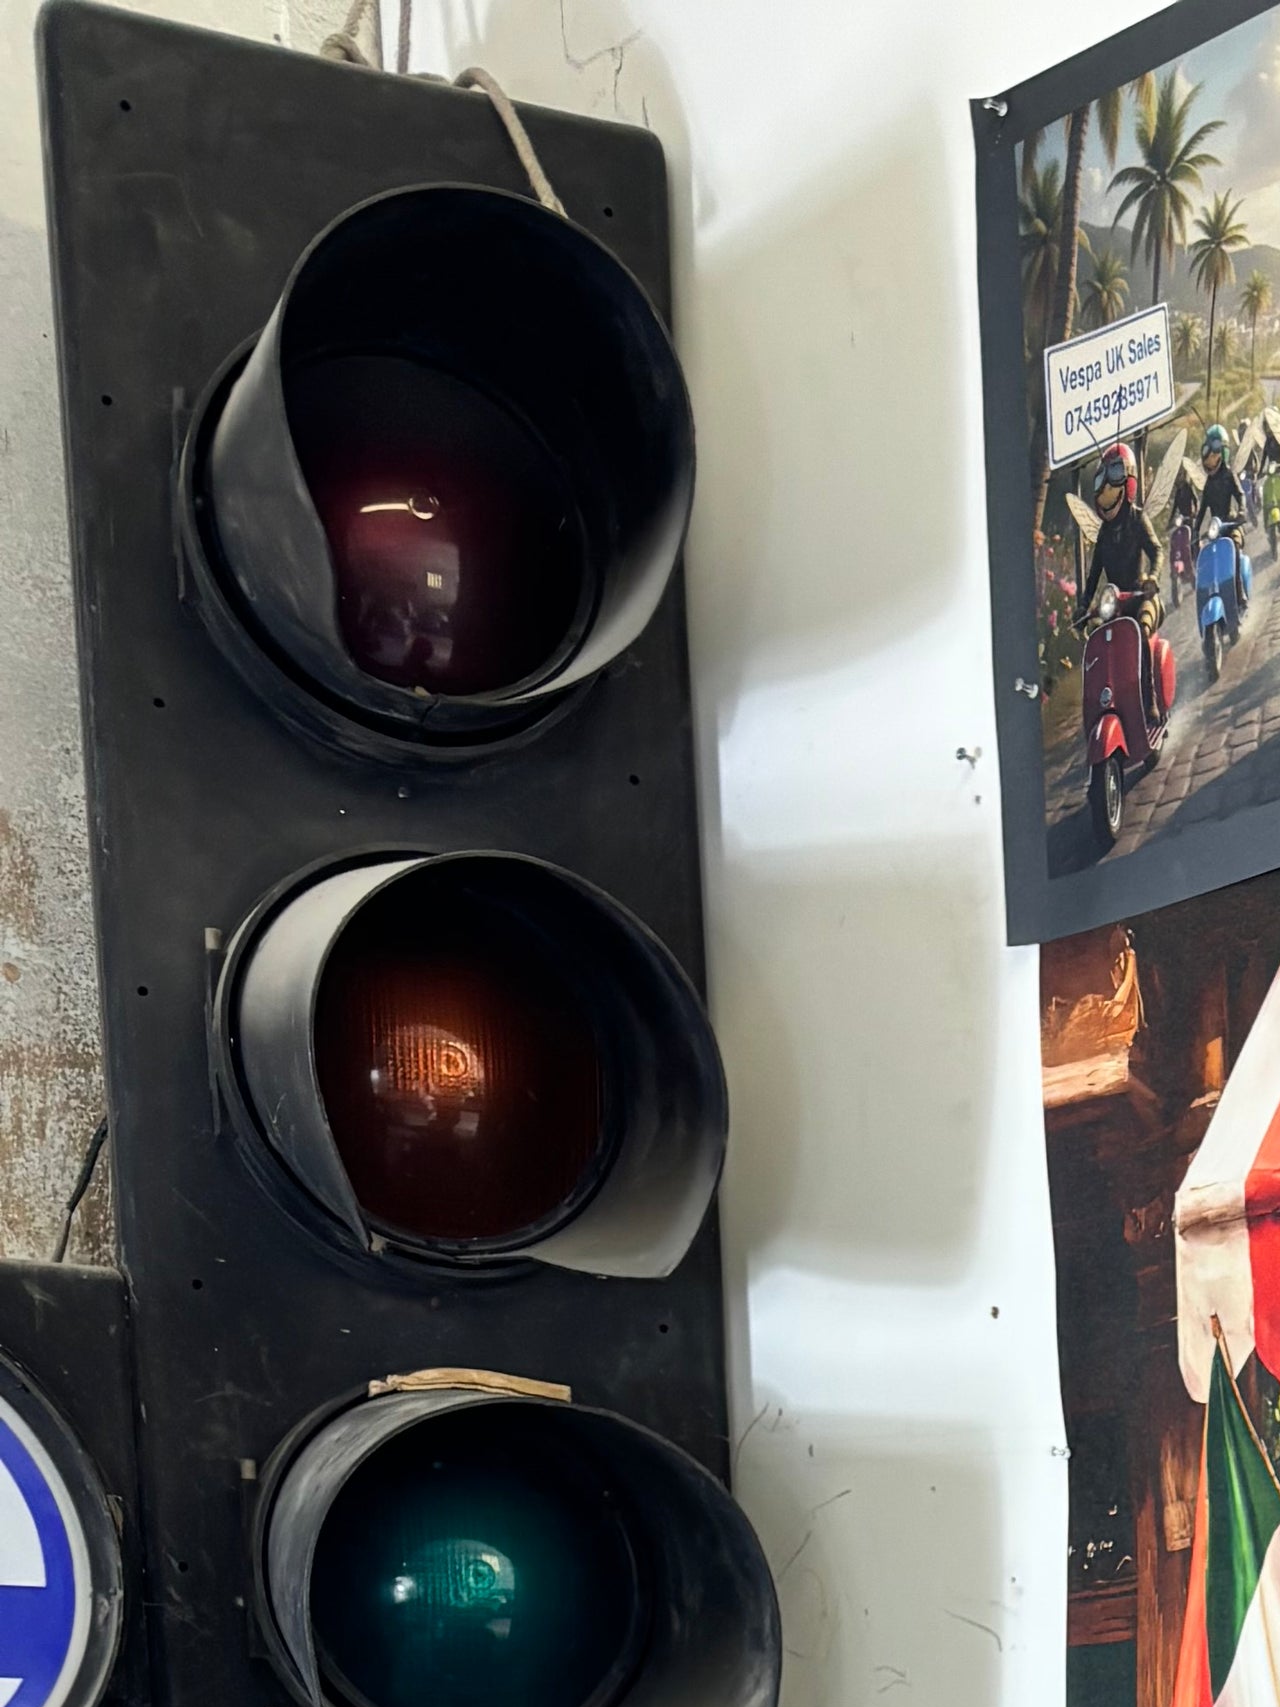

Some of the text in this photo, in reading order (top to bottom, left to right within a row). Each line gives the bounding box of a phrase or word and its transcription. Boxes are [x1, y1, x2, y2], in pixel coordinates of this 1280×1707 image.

[1059, 332, 1161, 393] Vespa UK Sales
[1064, 371, 1160, 436] 07459285971
